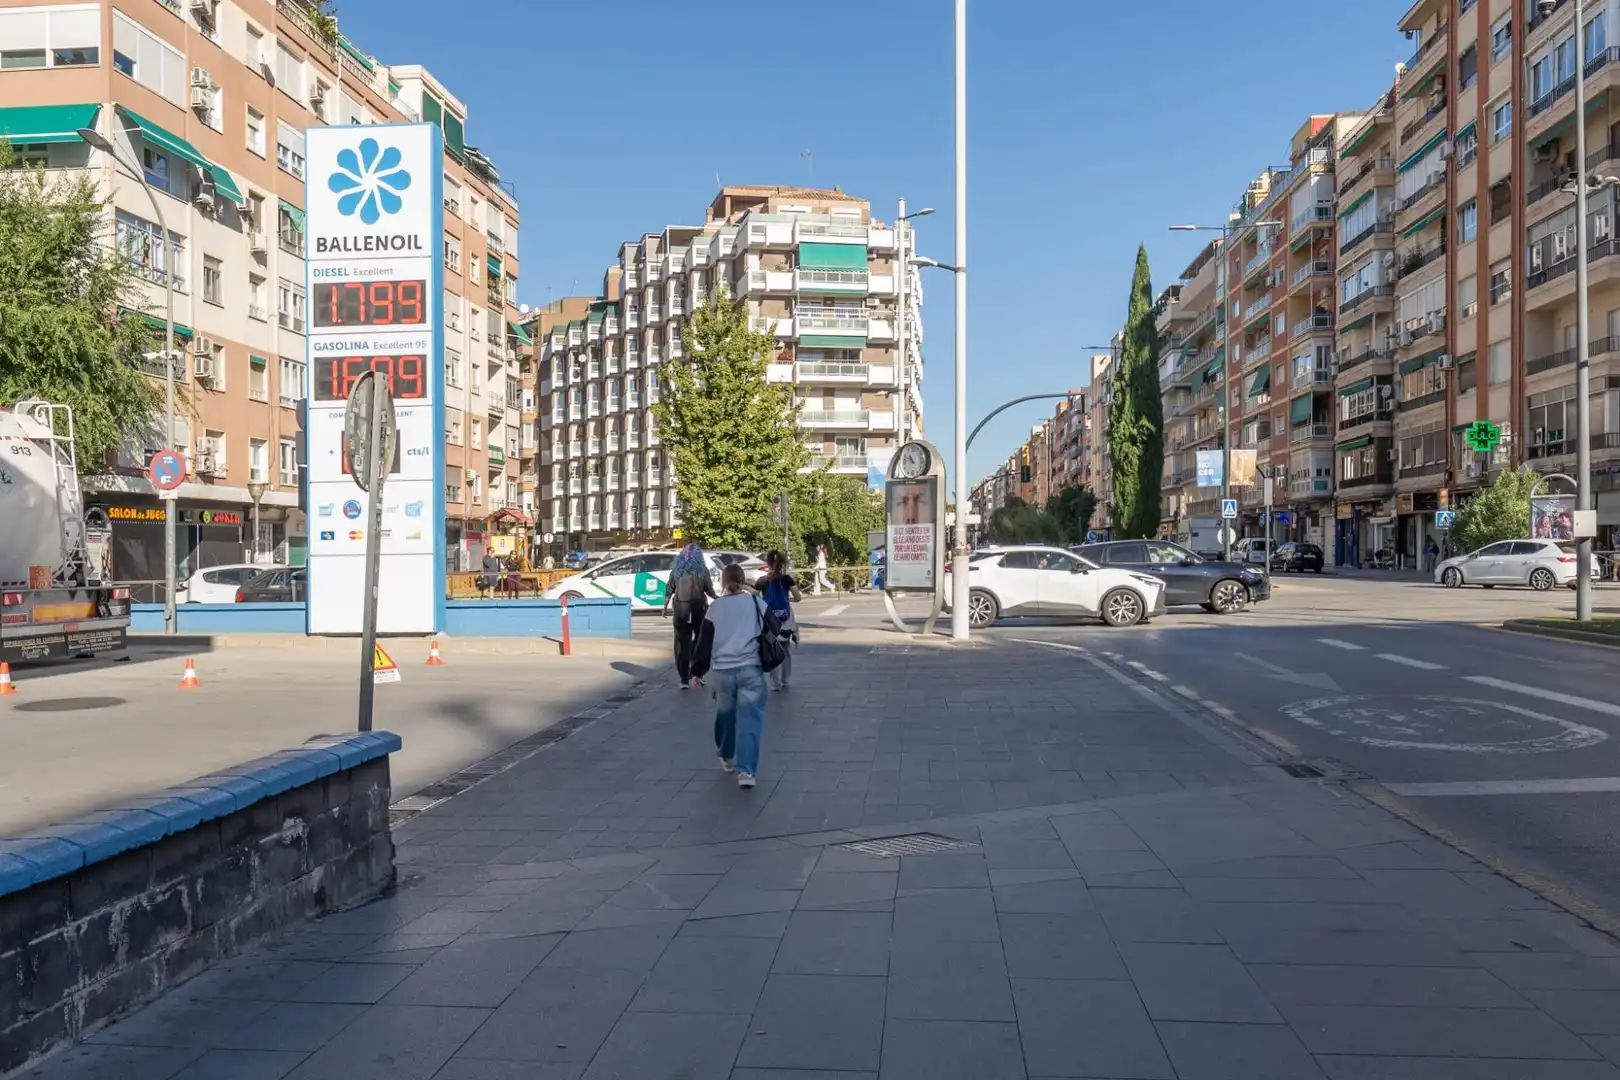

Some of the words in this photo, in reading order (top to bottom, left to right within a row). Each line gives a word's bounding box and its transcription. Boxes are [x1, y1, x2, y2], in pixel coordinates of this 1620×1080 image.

[316, 234, 422, 253] BALLENOIL
[313, 267, 350, 278] DIESEL
[353, 266, 394, 277] Excellent
[330, 280, 422, 325] 1.799
[313, 341, 369, 351] GASOLINA
[373, 340, 414, 350] Excellent
[415, 340, 426, 350] 95
[10, 445, 32, 457] 913
[145, 508, 168, 520] JUEG
